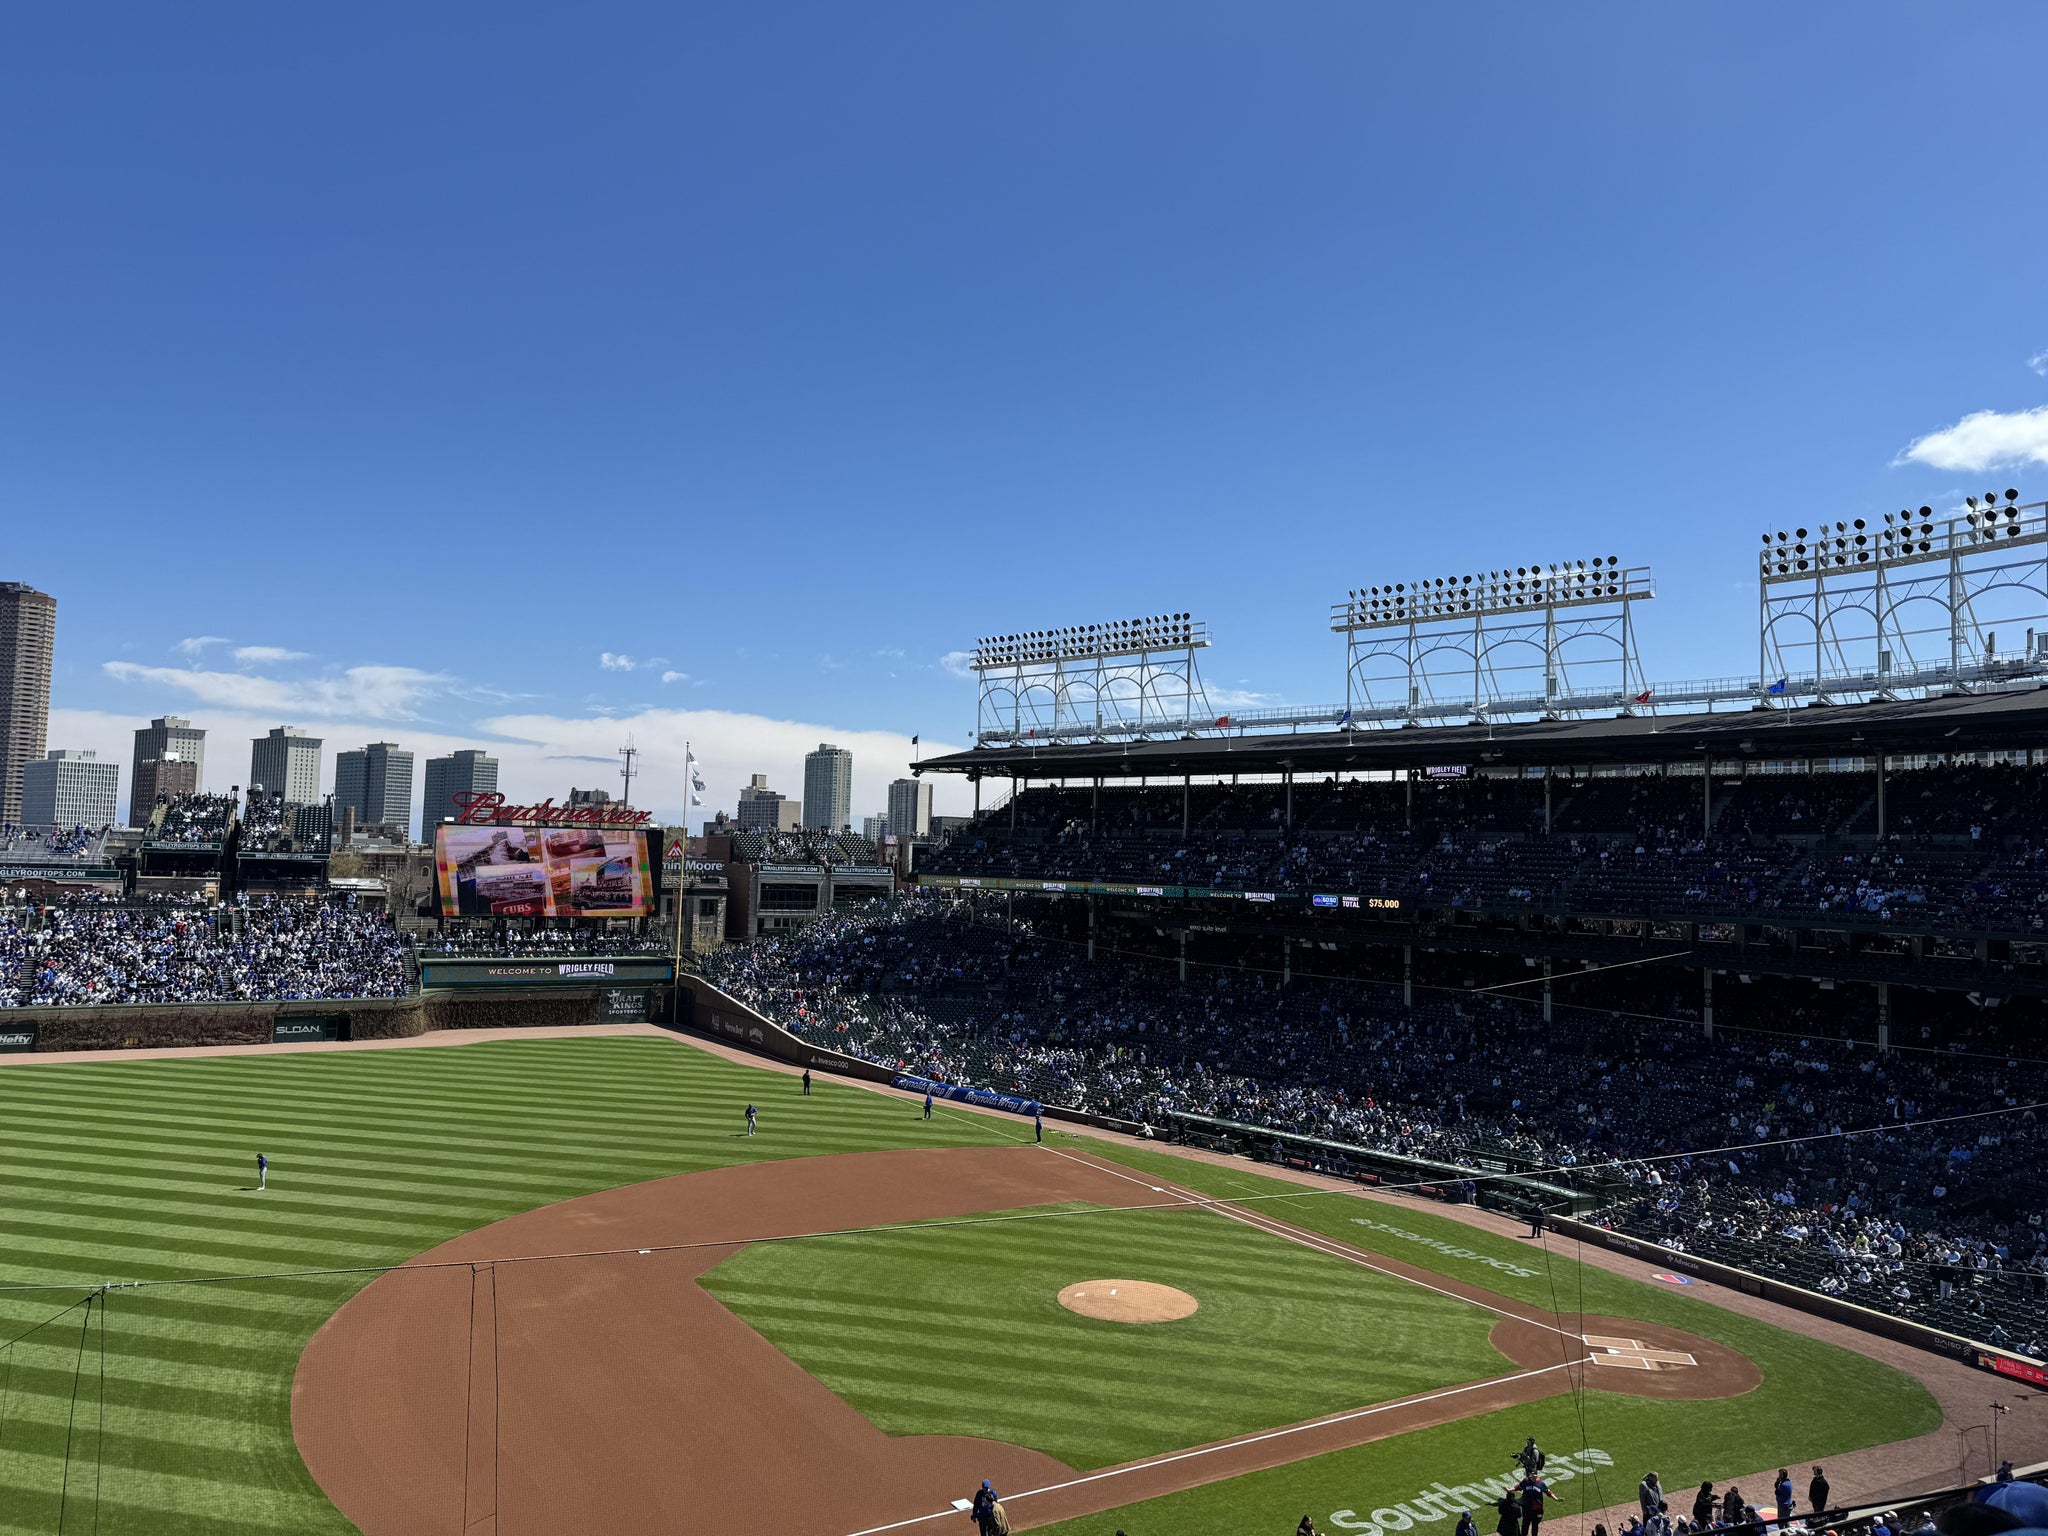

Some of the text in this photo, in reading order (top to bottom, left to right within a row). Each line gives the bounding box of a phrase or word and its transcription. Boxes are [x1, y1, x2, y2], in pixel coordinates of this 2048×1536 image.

[1426, 766, 1467, 776] WRIGLEY FIELD
[452, 791, 653, 824] Budweiser
[685, 860, 723, 871] Moore
[503, 903, 531, 914] CUBS
[1368, 899, 1400, 909] $75,000
[559, 964, 593, 976] WRIGLEY
[594, 964, 615, 975] FIELD
[608, 995, 645, 1004] DRAFT
[275, 1025, 320, 1034] SLOAN
[0, 1034, 31, 1045] Hefty
[898, 1078, 945, 1096] Reynolds Wrap
[965, 1091, 1019, 1112] Reynolds Wrap
[1367, 1223, 1543, 1278] Southwest
[1673, 1257, 1700, 1270] Advocate
[1934, 1336, 1962, 1350] DAISO
